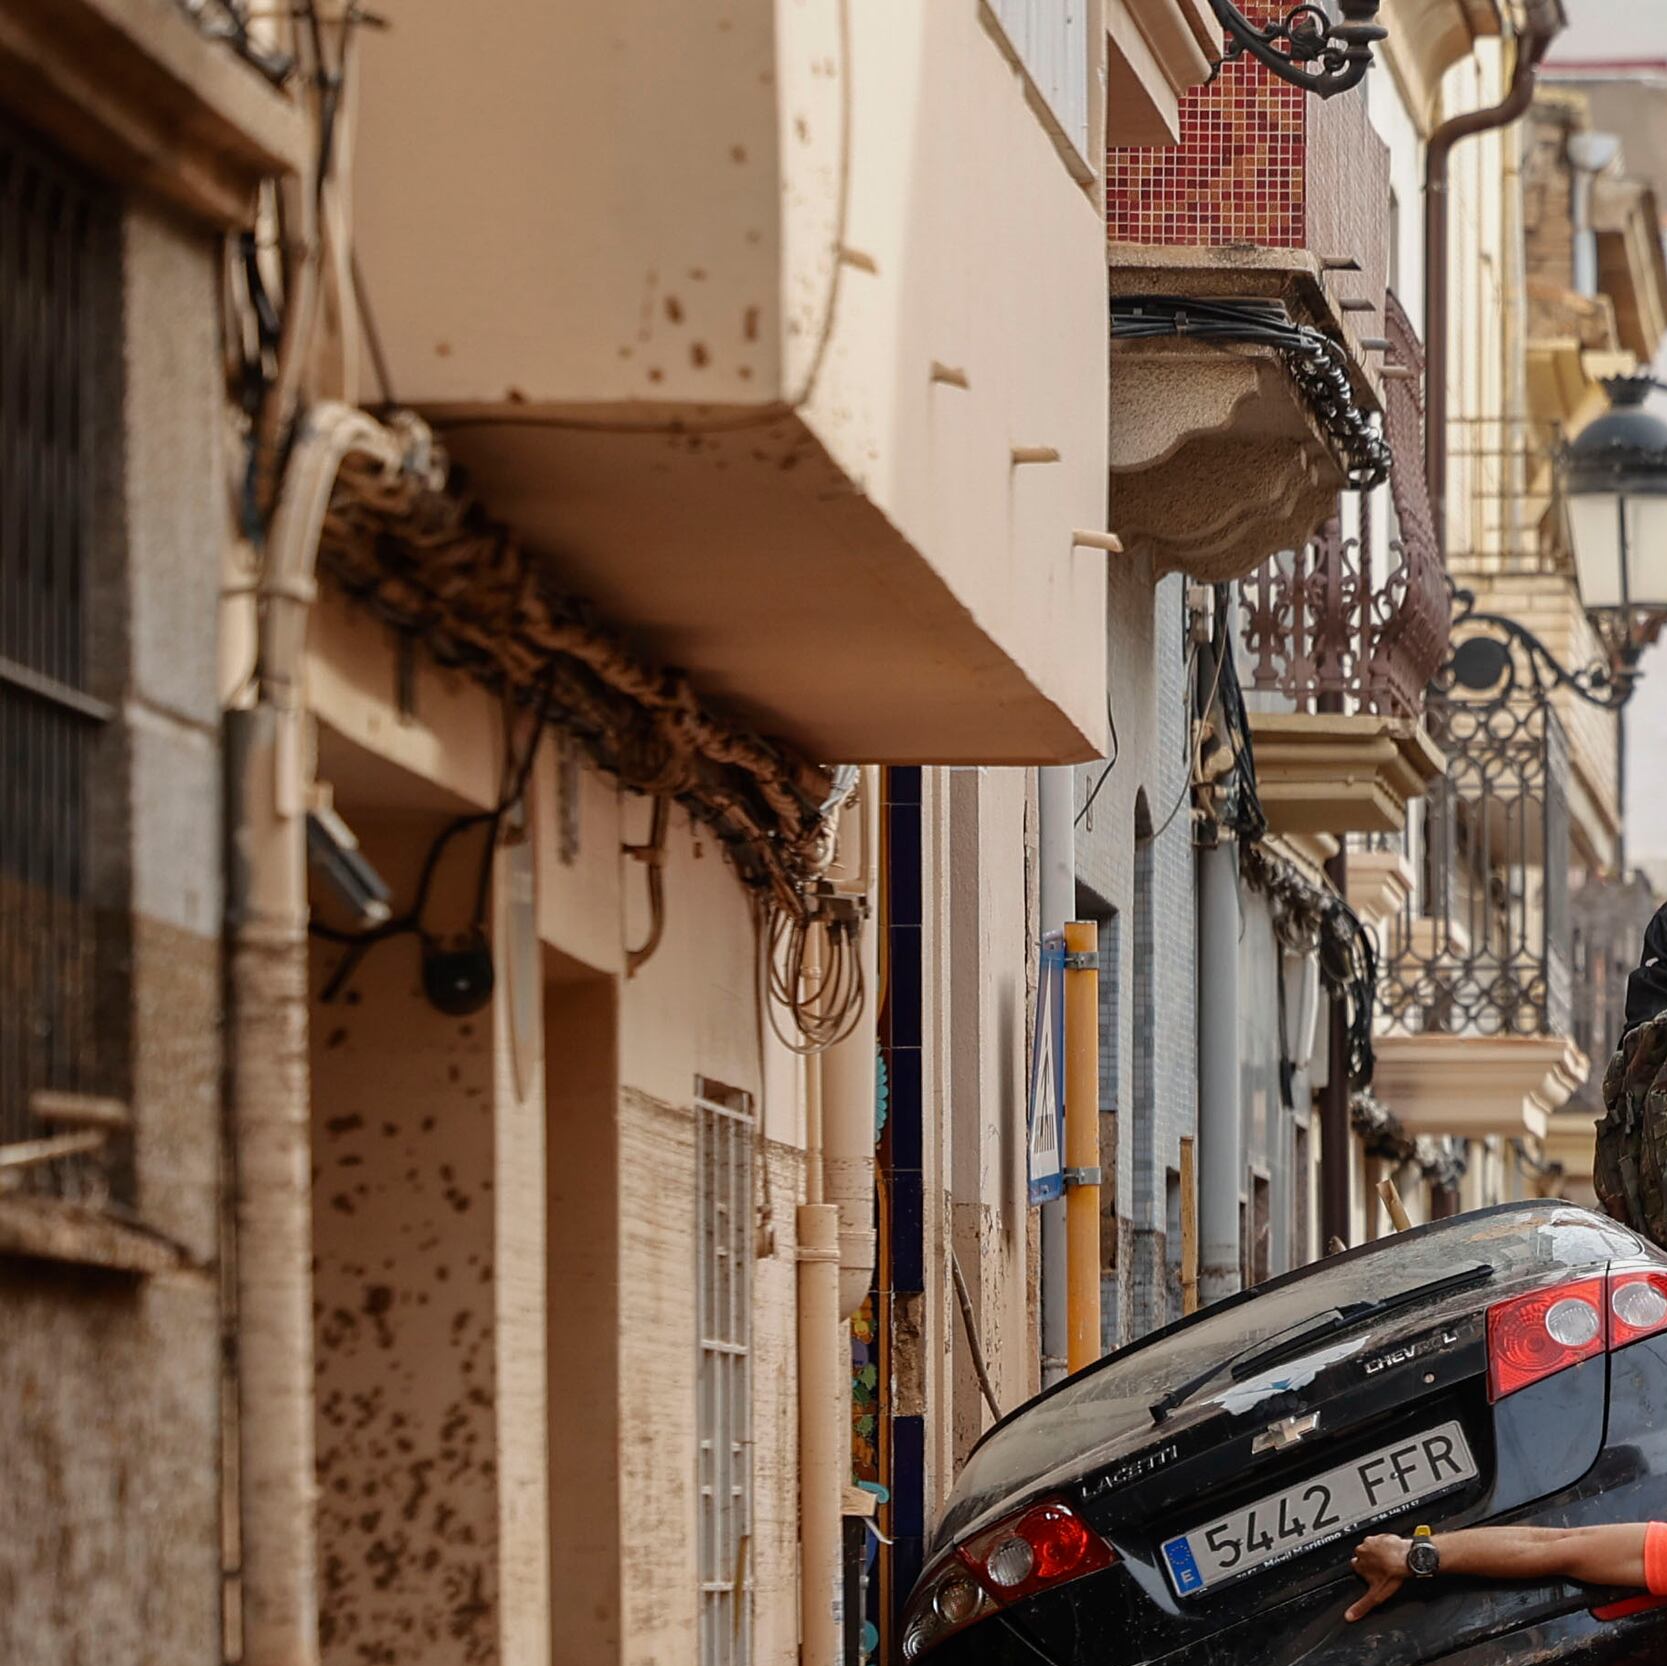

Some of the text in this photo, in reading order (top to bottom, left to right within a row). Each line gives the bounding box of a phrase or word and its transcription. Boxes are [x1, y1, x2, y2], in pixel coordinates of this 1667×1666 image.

[1181, 1434, 1464, 1584] E 5442 FFR
